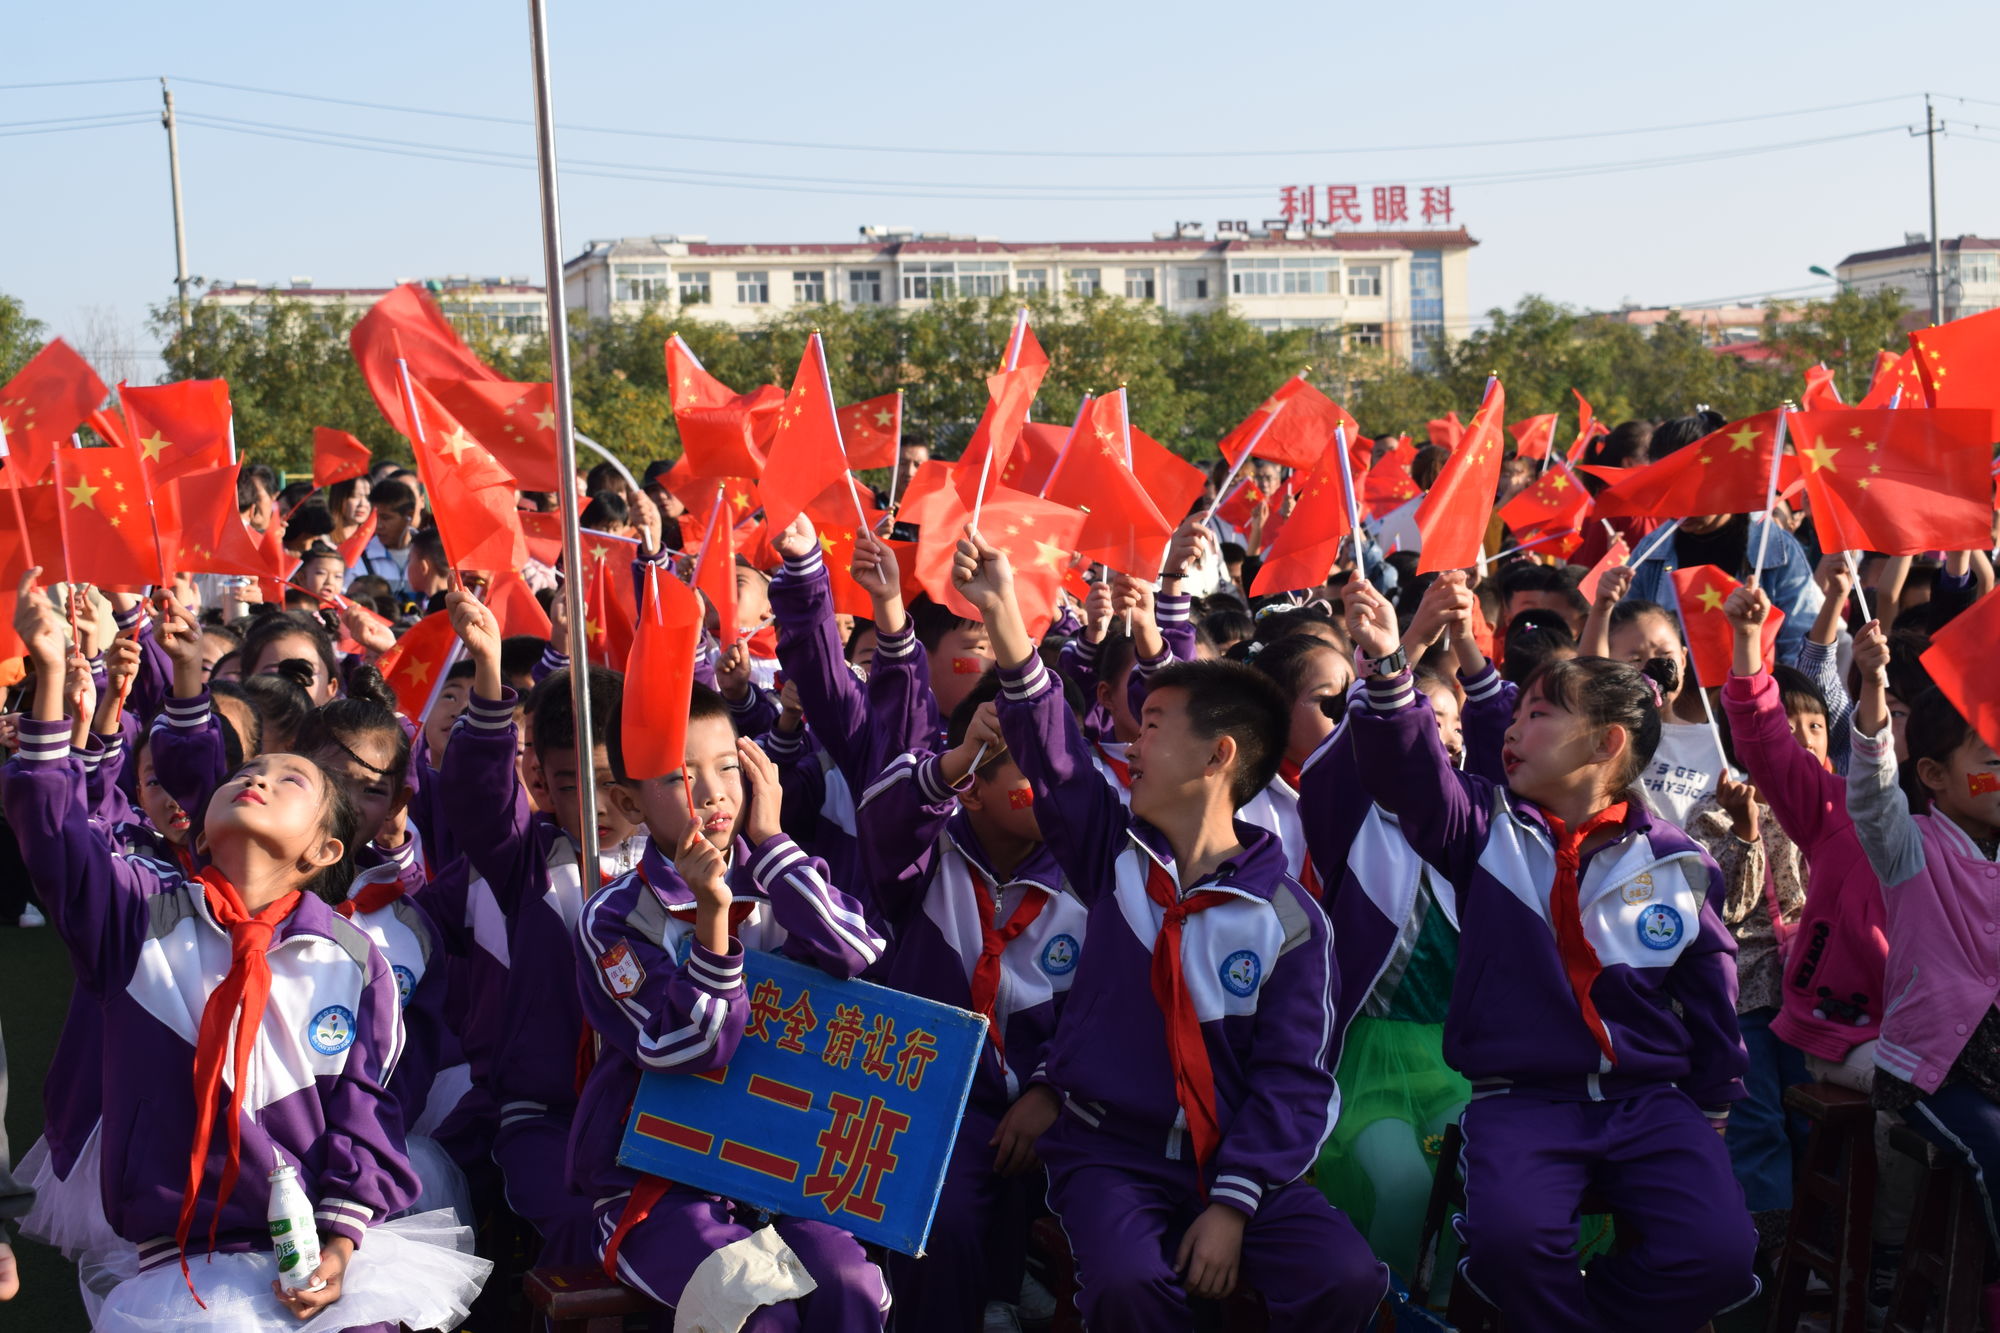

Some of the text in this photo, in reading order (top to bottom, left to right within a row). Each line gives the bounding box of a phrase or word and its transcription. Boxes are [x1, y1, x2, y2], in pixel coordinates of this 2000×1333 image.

[1279, 184, 1454, 225] 利民眼科
[1675, 766, 1706, 783] GET
[739, 974, 819, 1054] 安全
